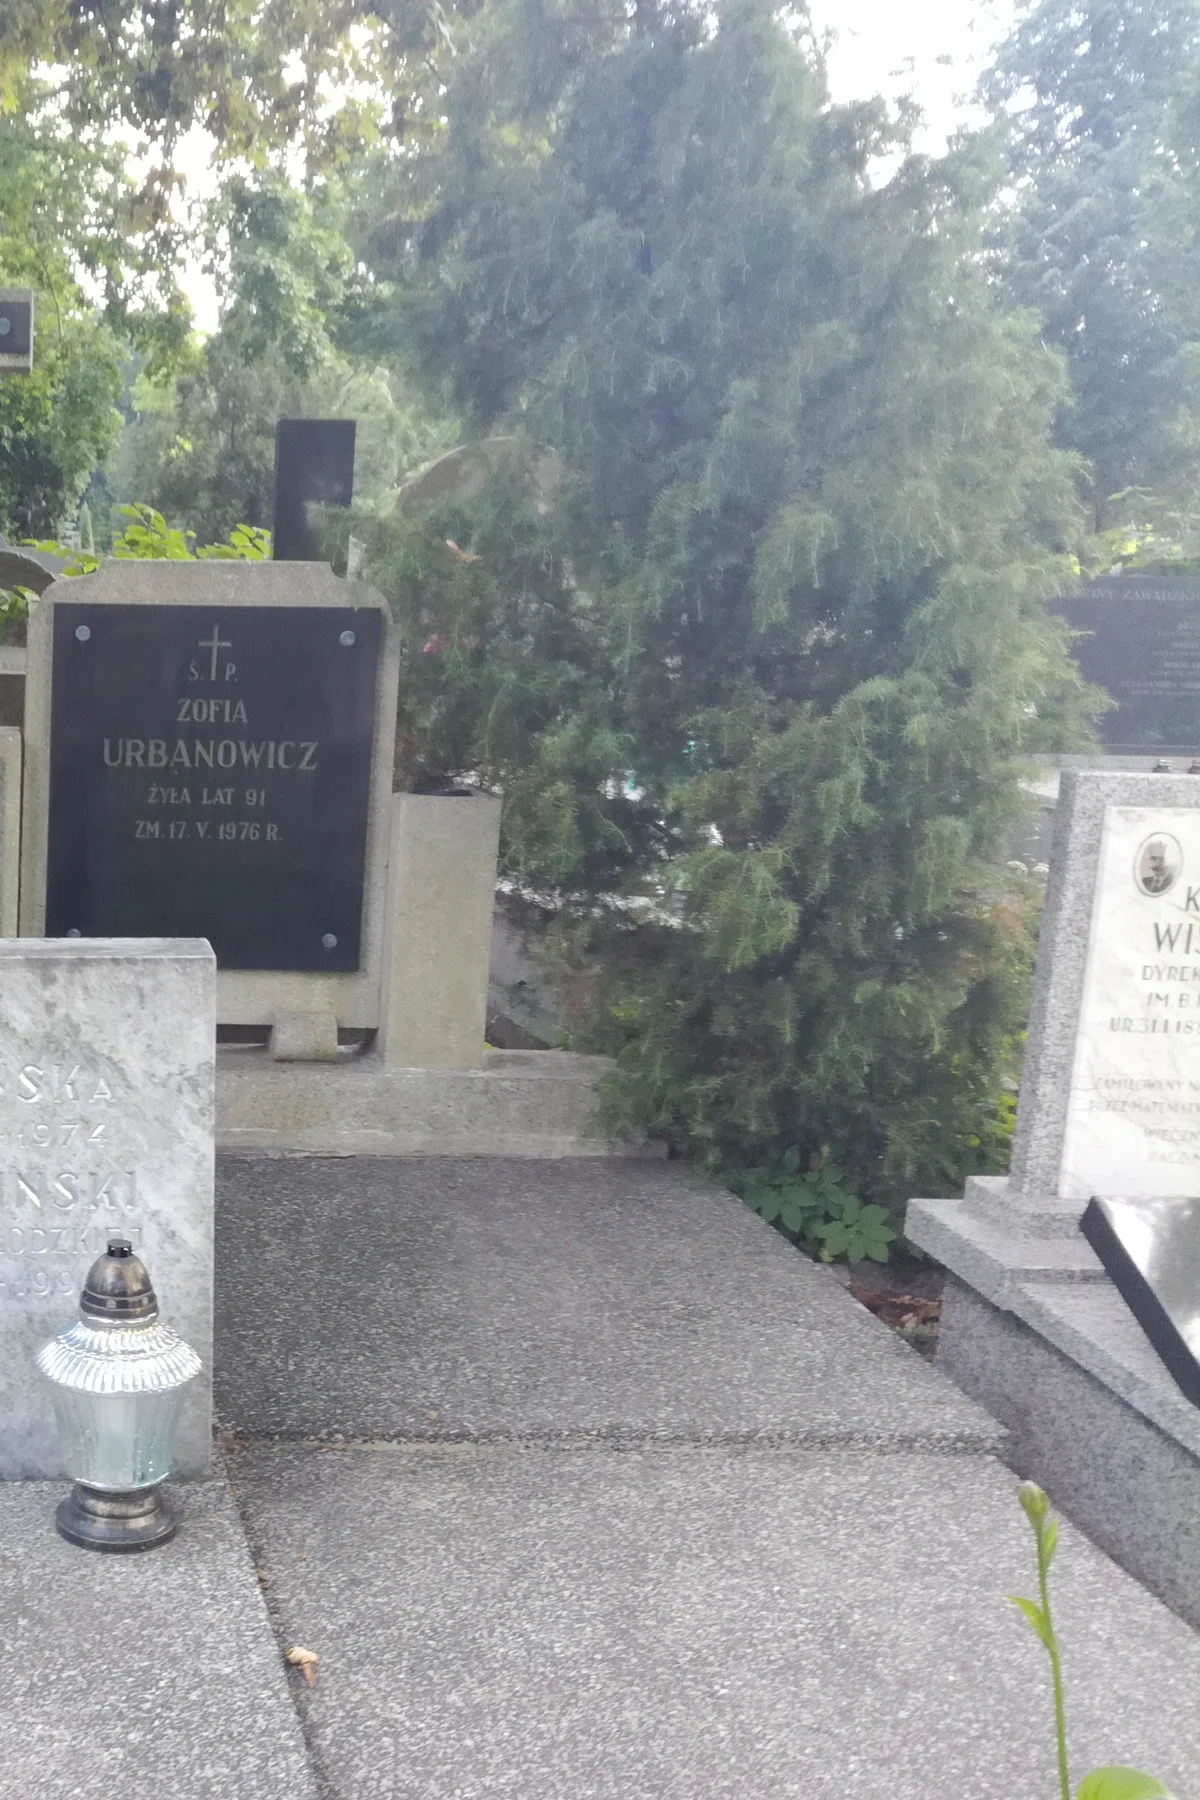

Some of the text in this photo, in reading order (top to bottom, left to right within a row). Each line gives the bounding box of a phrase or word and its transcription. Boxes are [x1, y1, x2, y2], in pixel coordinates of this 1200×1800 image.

[176, 698, 249, 724] ZOFIA
[103, 738, 319, 771] URBANOWICZ
[202, 787, 235, 805] LAT
[245, 788, 266, 806] 91
[217, 822, 261, 841] 1976
